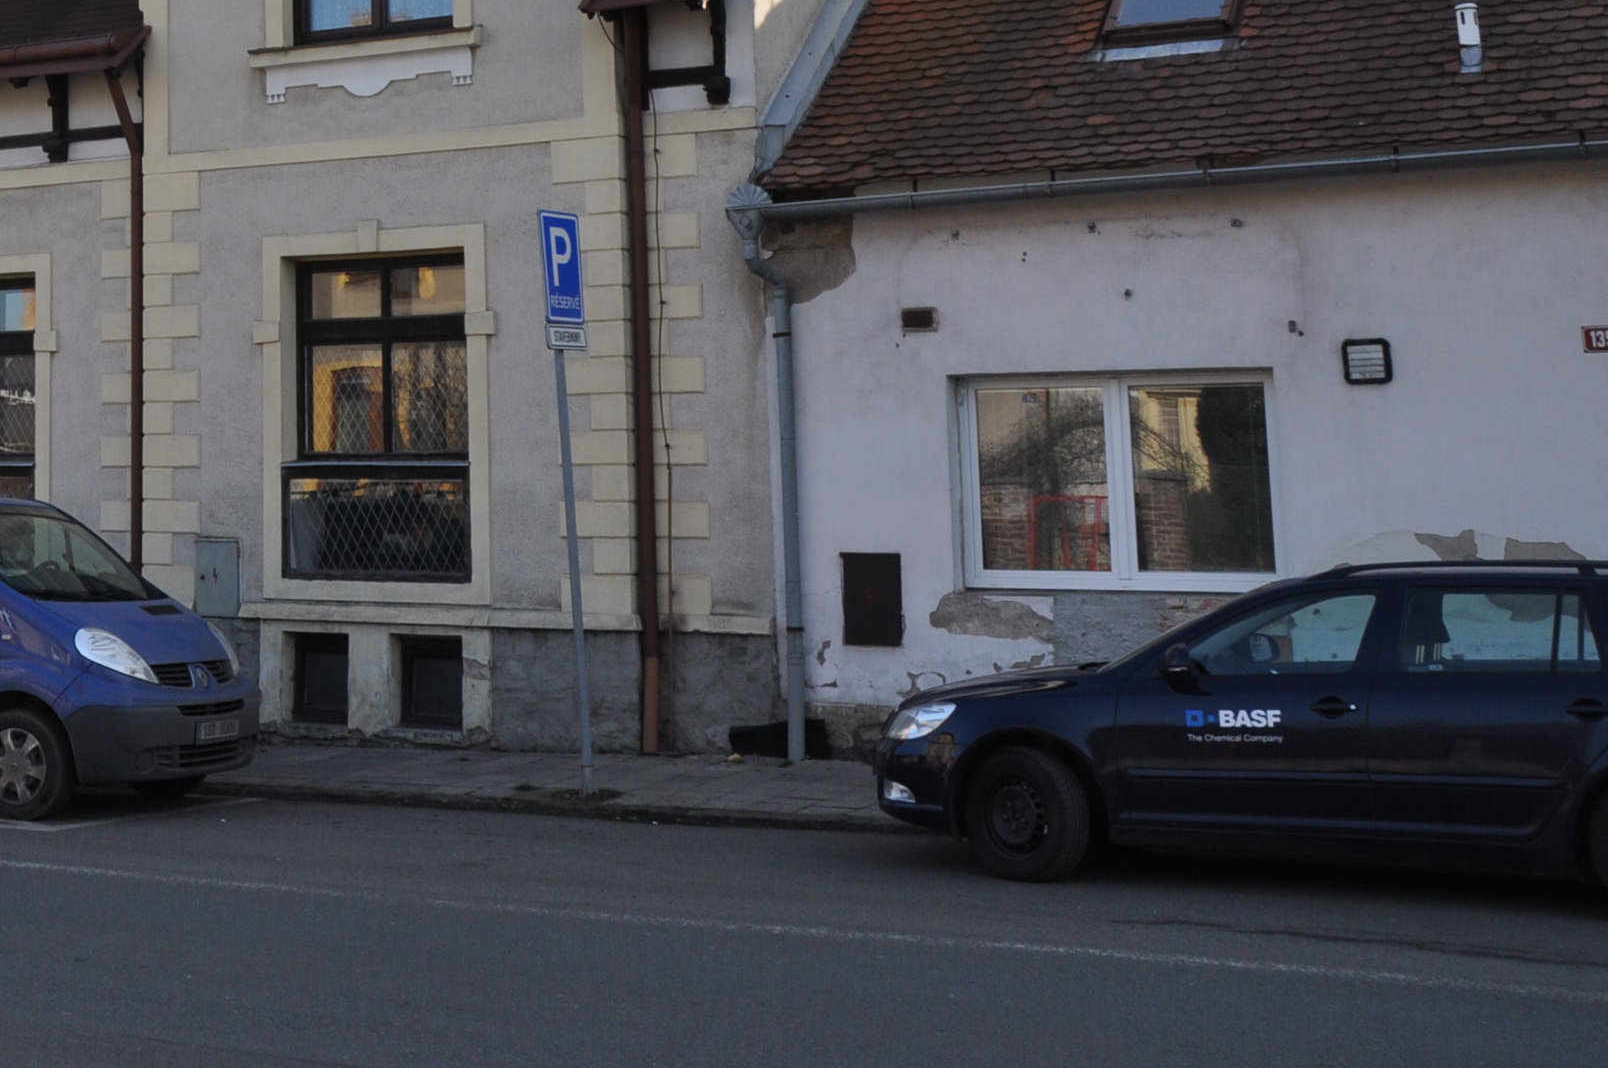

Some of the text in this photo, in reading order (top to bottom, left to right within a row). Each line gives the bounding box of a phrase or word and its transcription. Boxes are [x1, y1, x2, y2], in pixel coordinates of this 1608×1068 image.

[549, 226, 572, 287] P
[1218, 709, 1282, 728] BASF
[1187, 733, 1284, 744] The Chemical Company
